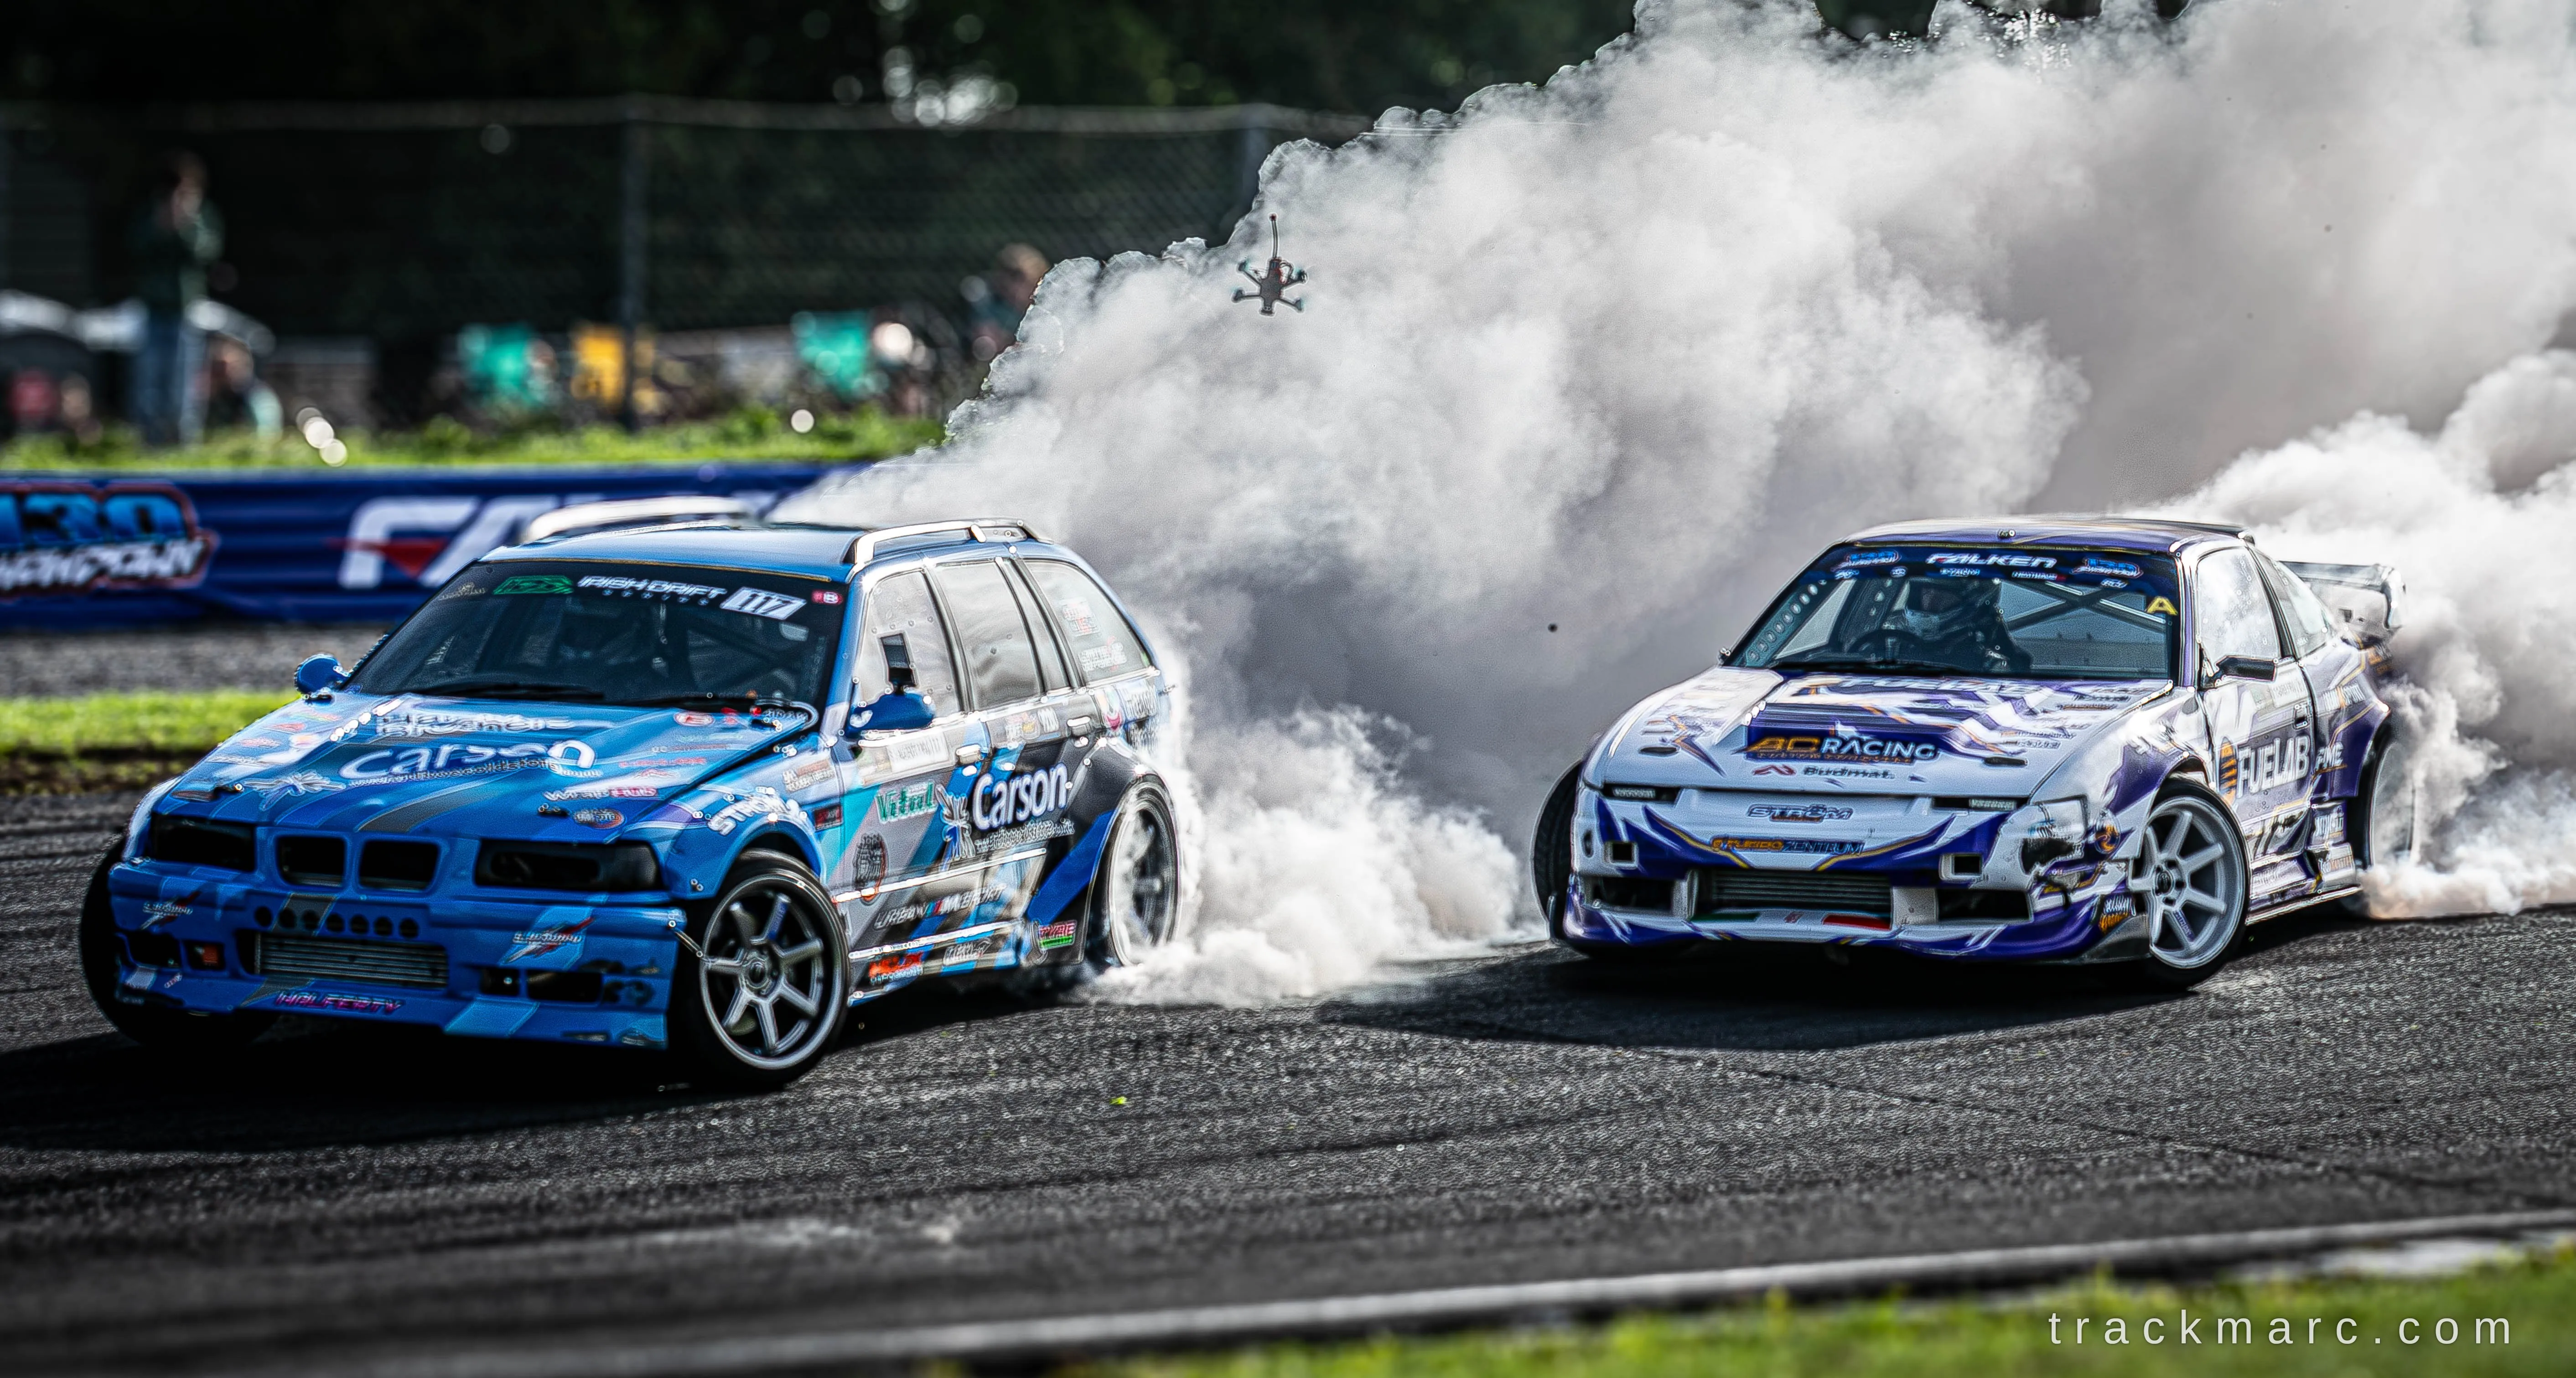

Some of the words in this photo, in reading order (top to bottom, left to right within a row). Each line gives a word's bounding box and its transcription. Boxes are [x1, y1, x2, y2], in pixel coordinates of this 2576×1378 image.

[1926, 553, 2057, 568] FALKEN
[2146, 596, 2178, 616] A
[339, 740, 596, 780] Carson
[1822, 737, 1936, 759] RACING
[2236, 734, 2311, 799] FUELAB
[876, 780, 936, 823] Vital
[972, 763, 1068, 830] Carson
